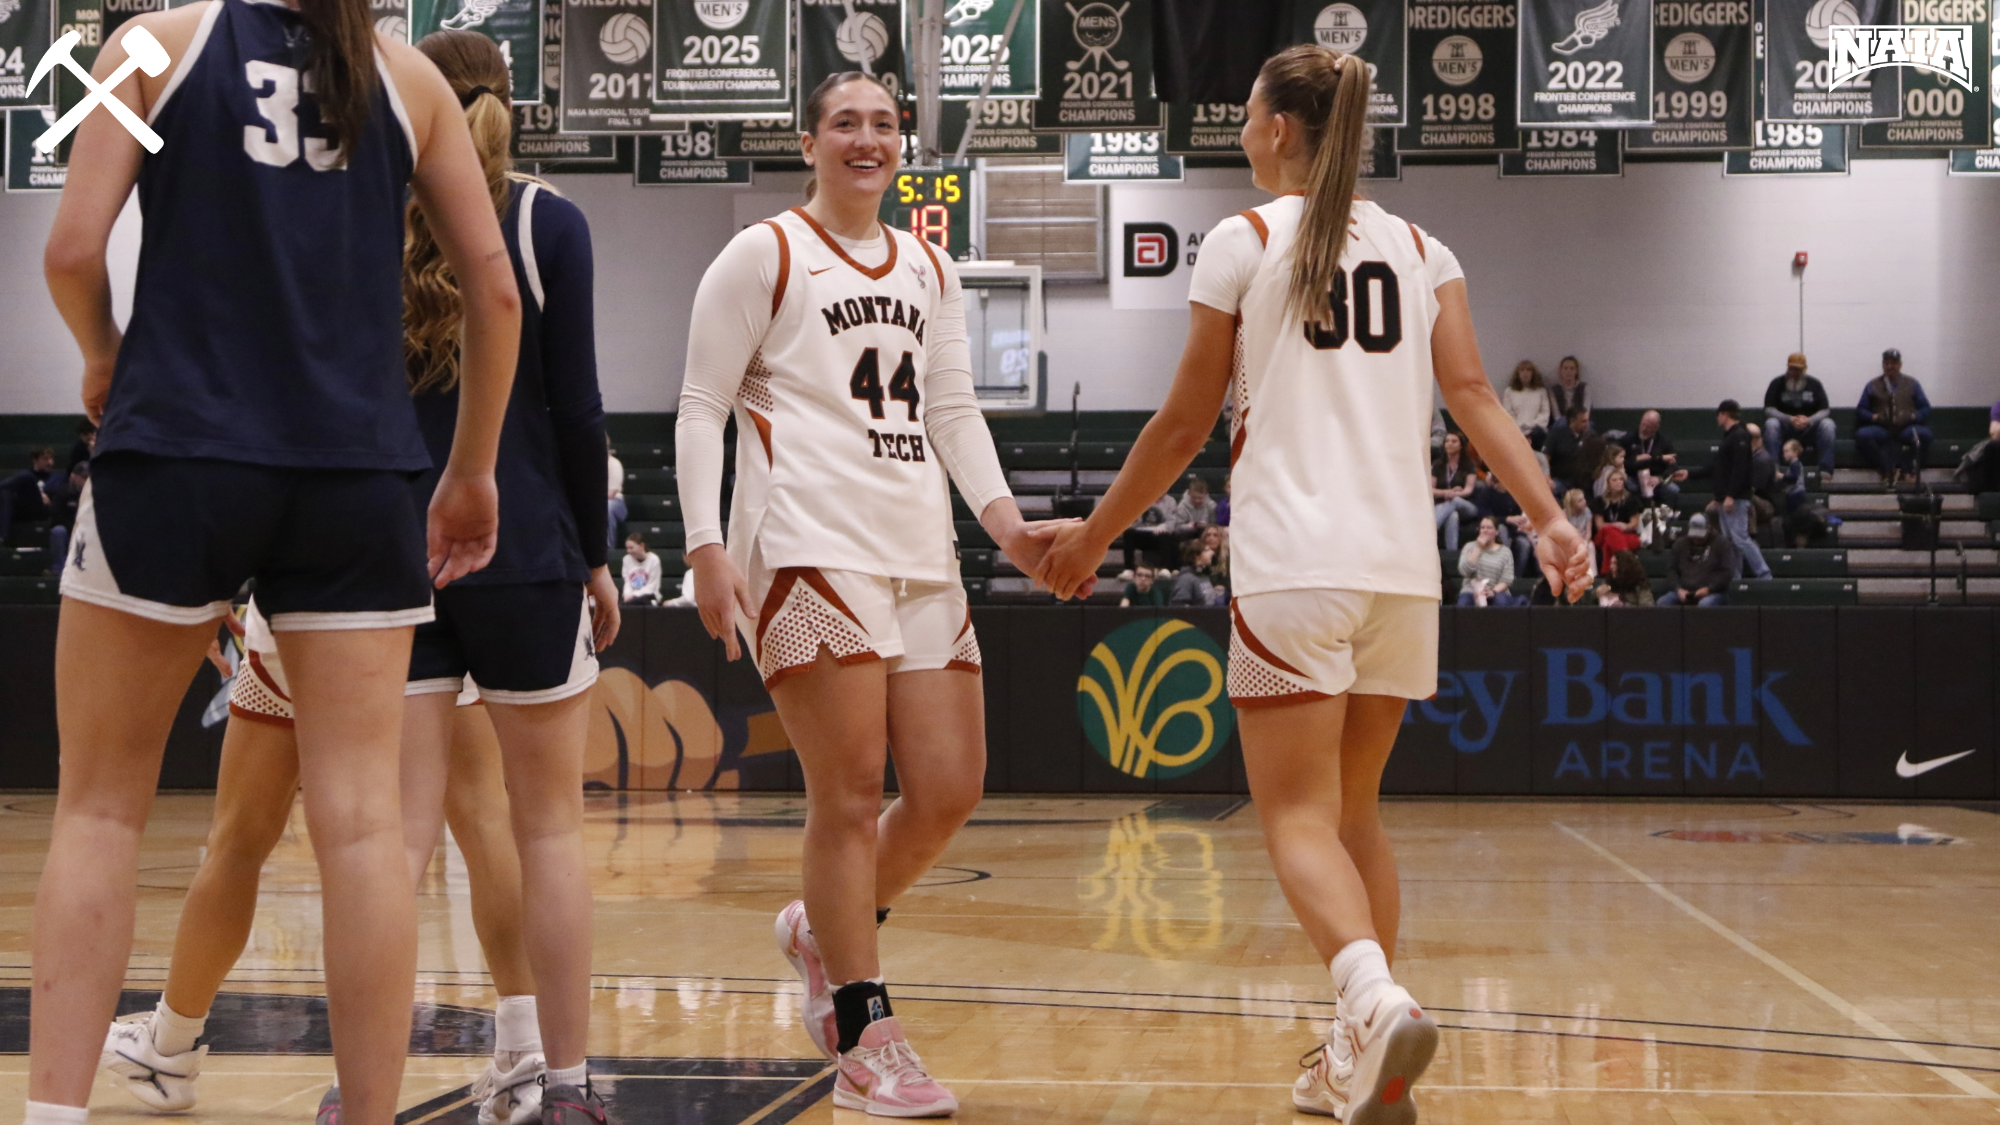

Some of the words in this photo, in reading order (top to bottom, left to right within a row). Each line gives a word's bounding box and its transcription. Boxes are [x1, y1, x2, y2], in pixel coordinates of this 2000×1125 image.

[700, 3, 743, 16] MEN'S
[1656, 2, 1748, 25] EDIGGERS
[1078, 16, 1117, 27] MENS
[1320, 31, 1361, 44] MEN'S
[683, 35, 760, 65] 2025
[1438, 61, 1478, 74] MEN'S
[1669, 59, 1711, 72] MEN'S
[666, 68, 708, 78] FRONTIER
[709, 68, 767, 78] CONFERENCE
[768, 68, 776, 77] &
[1548, 61, 1623, 89] 2022
[662, 80, 724, 90] TOURNAMENT
[725, 80, 780, 90] CHAMPIONS
[1063, 72, 1133, 99] 2021
[1534, 92, 1576, 102] FRONTIER
[1577, 92, 1636, 102] CONFERENCE
[1904, 88, 1964, 117] 000
[1422, 93, 1495, 120] 1998
[1557, 104, 1612, 114] CHAMPIONS
[1654, 91, 1727, 118] 1999
[1793, 102, 1873, 115] CHAMPIONS
[567, 108, 587, 116] NAIA
[588, 108, 627, 116] NATIONAL
[1059, 109, 1136, 122] CHAMPIONS
[607, 118, 631, 126] FINAL
[1421, 133, 1495, 144] CHAMPIONS
[1652, 130, 1727, 143] CHAMPIONS
[1755, 121, 1823, 147] 1985
[1887, 128, 1963, 141] CHAMPIONS
[518, 141, 591, 153] CHAMPIONS
[661, 131, 716, 157] 198
[1090, 132, 1159, 154] 1983
[1088, 163, 1160, 176] CHAMPIONS
[1525, 159, 1596, 171] CHAMPIONS
[1750, 157, 1822, 169] CHAMPIONS
[660, 166, 728, 179] CHAMPIONS
[898, 174, 960, 203] 5:15
[849, 347, 920, 422] 44
[868, 429, 926, 462] TECH
[1540, 648, 1813, 746] Bank
[1554, 741, 1765, 780] ARENA
